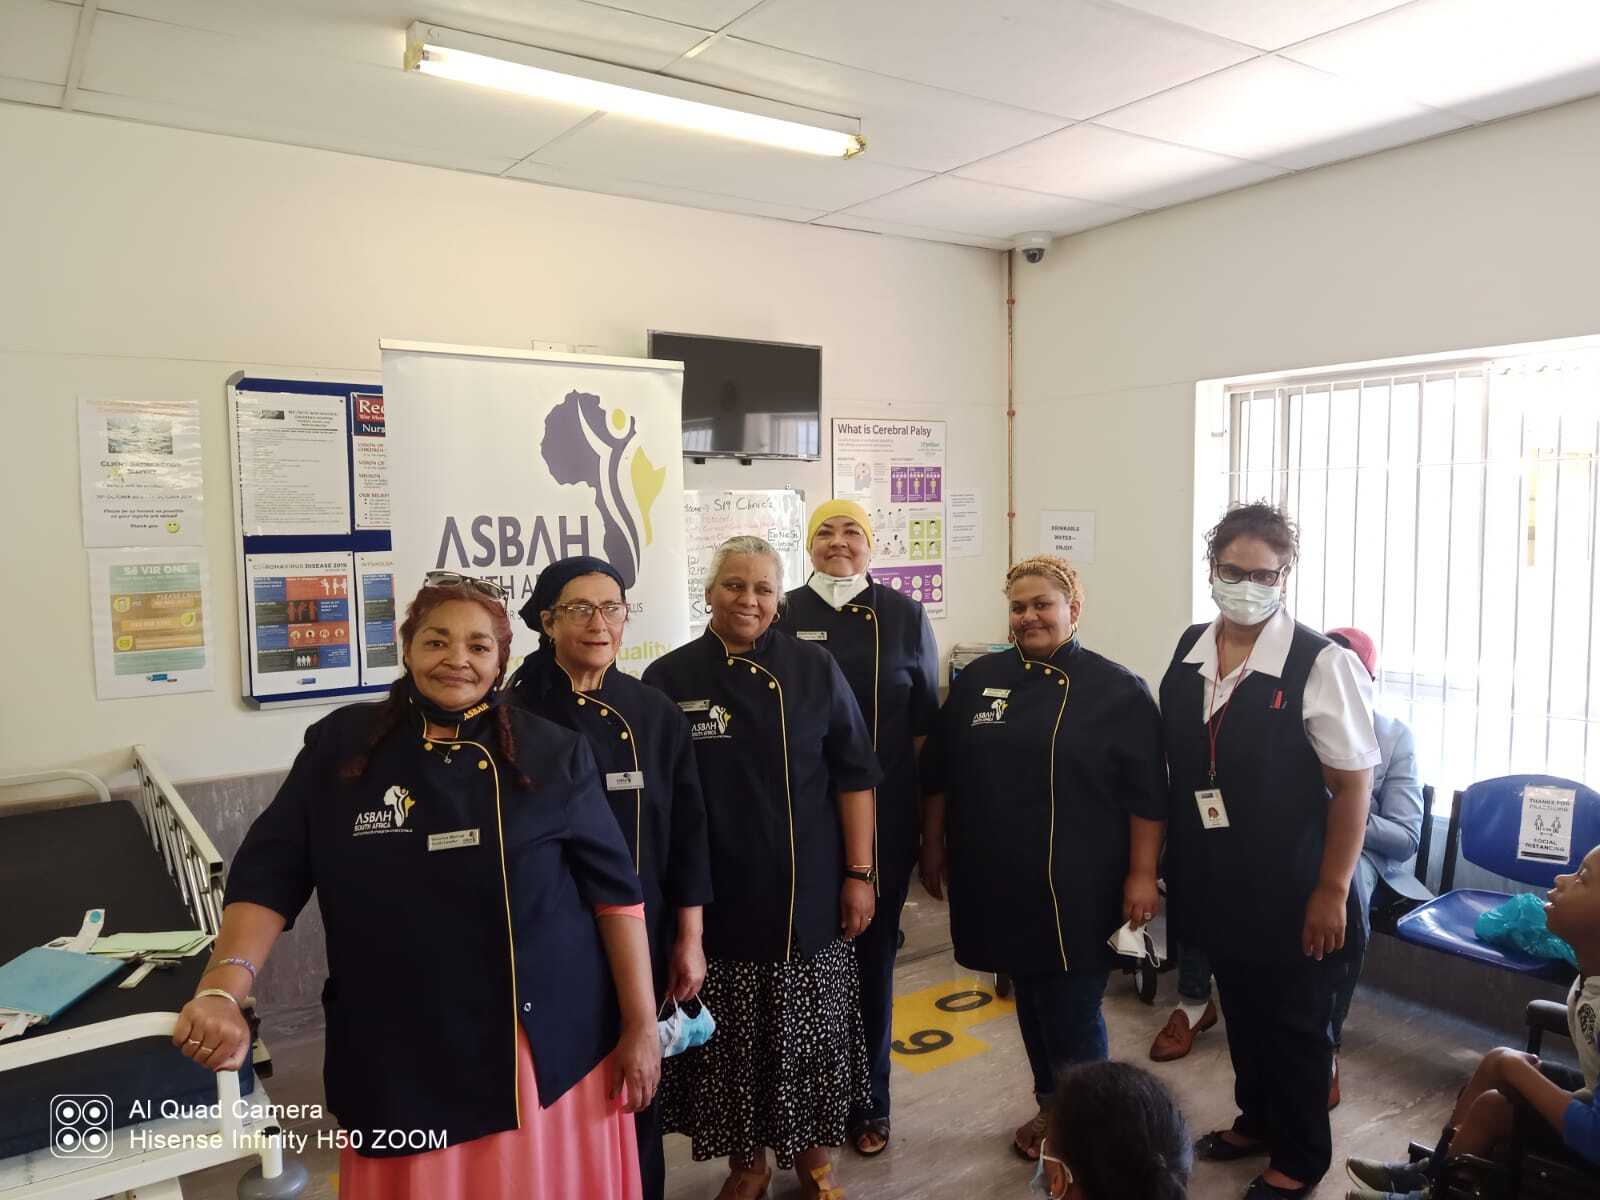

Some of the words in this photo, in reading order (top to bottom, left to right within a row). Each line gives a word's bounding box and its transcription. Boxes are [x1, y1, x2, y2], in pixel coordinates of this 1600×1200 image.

[838, 424, 861, 434] What
[864, 424, 870, 434] is
[872, 424, 908, 435] Cerebral
[910, 425, 931, 438] Palsy
[435, 515, 590, 569] ASBAH
[355, 810, 392, 825] ASBAH
